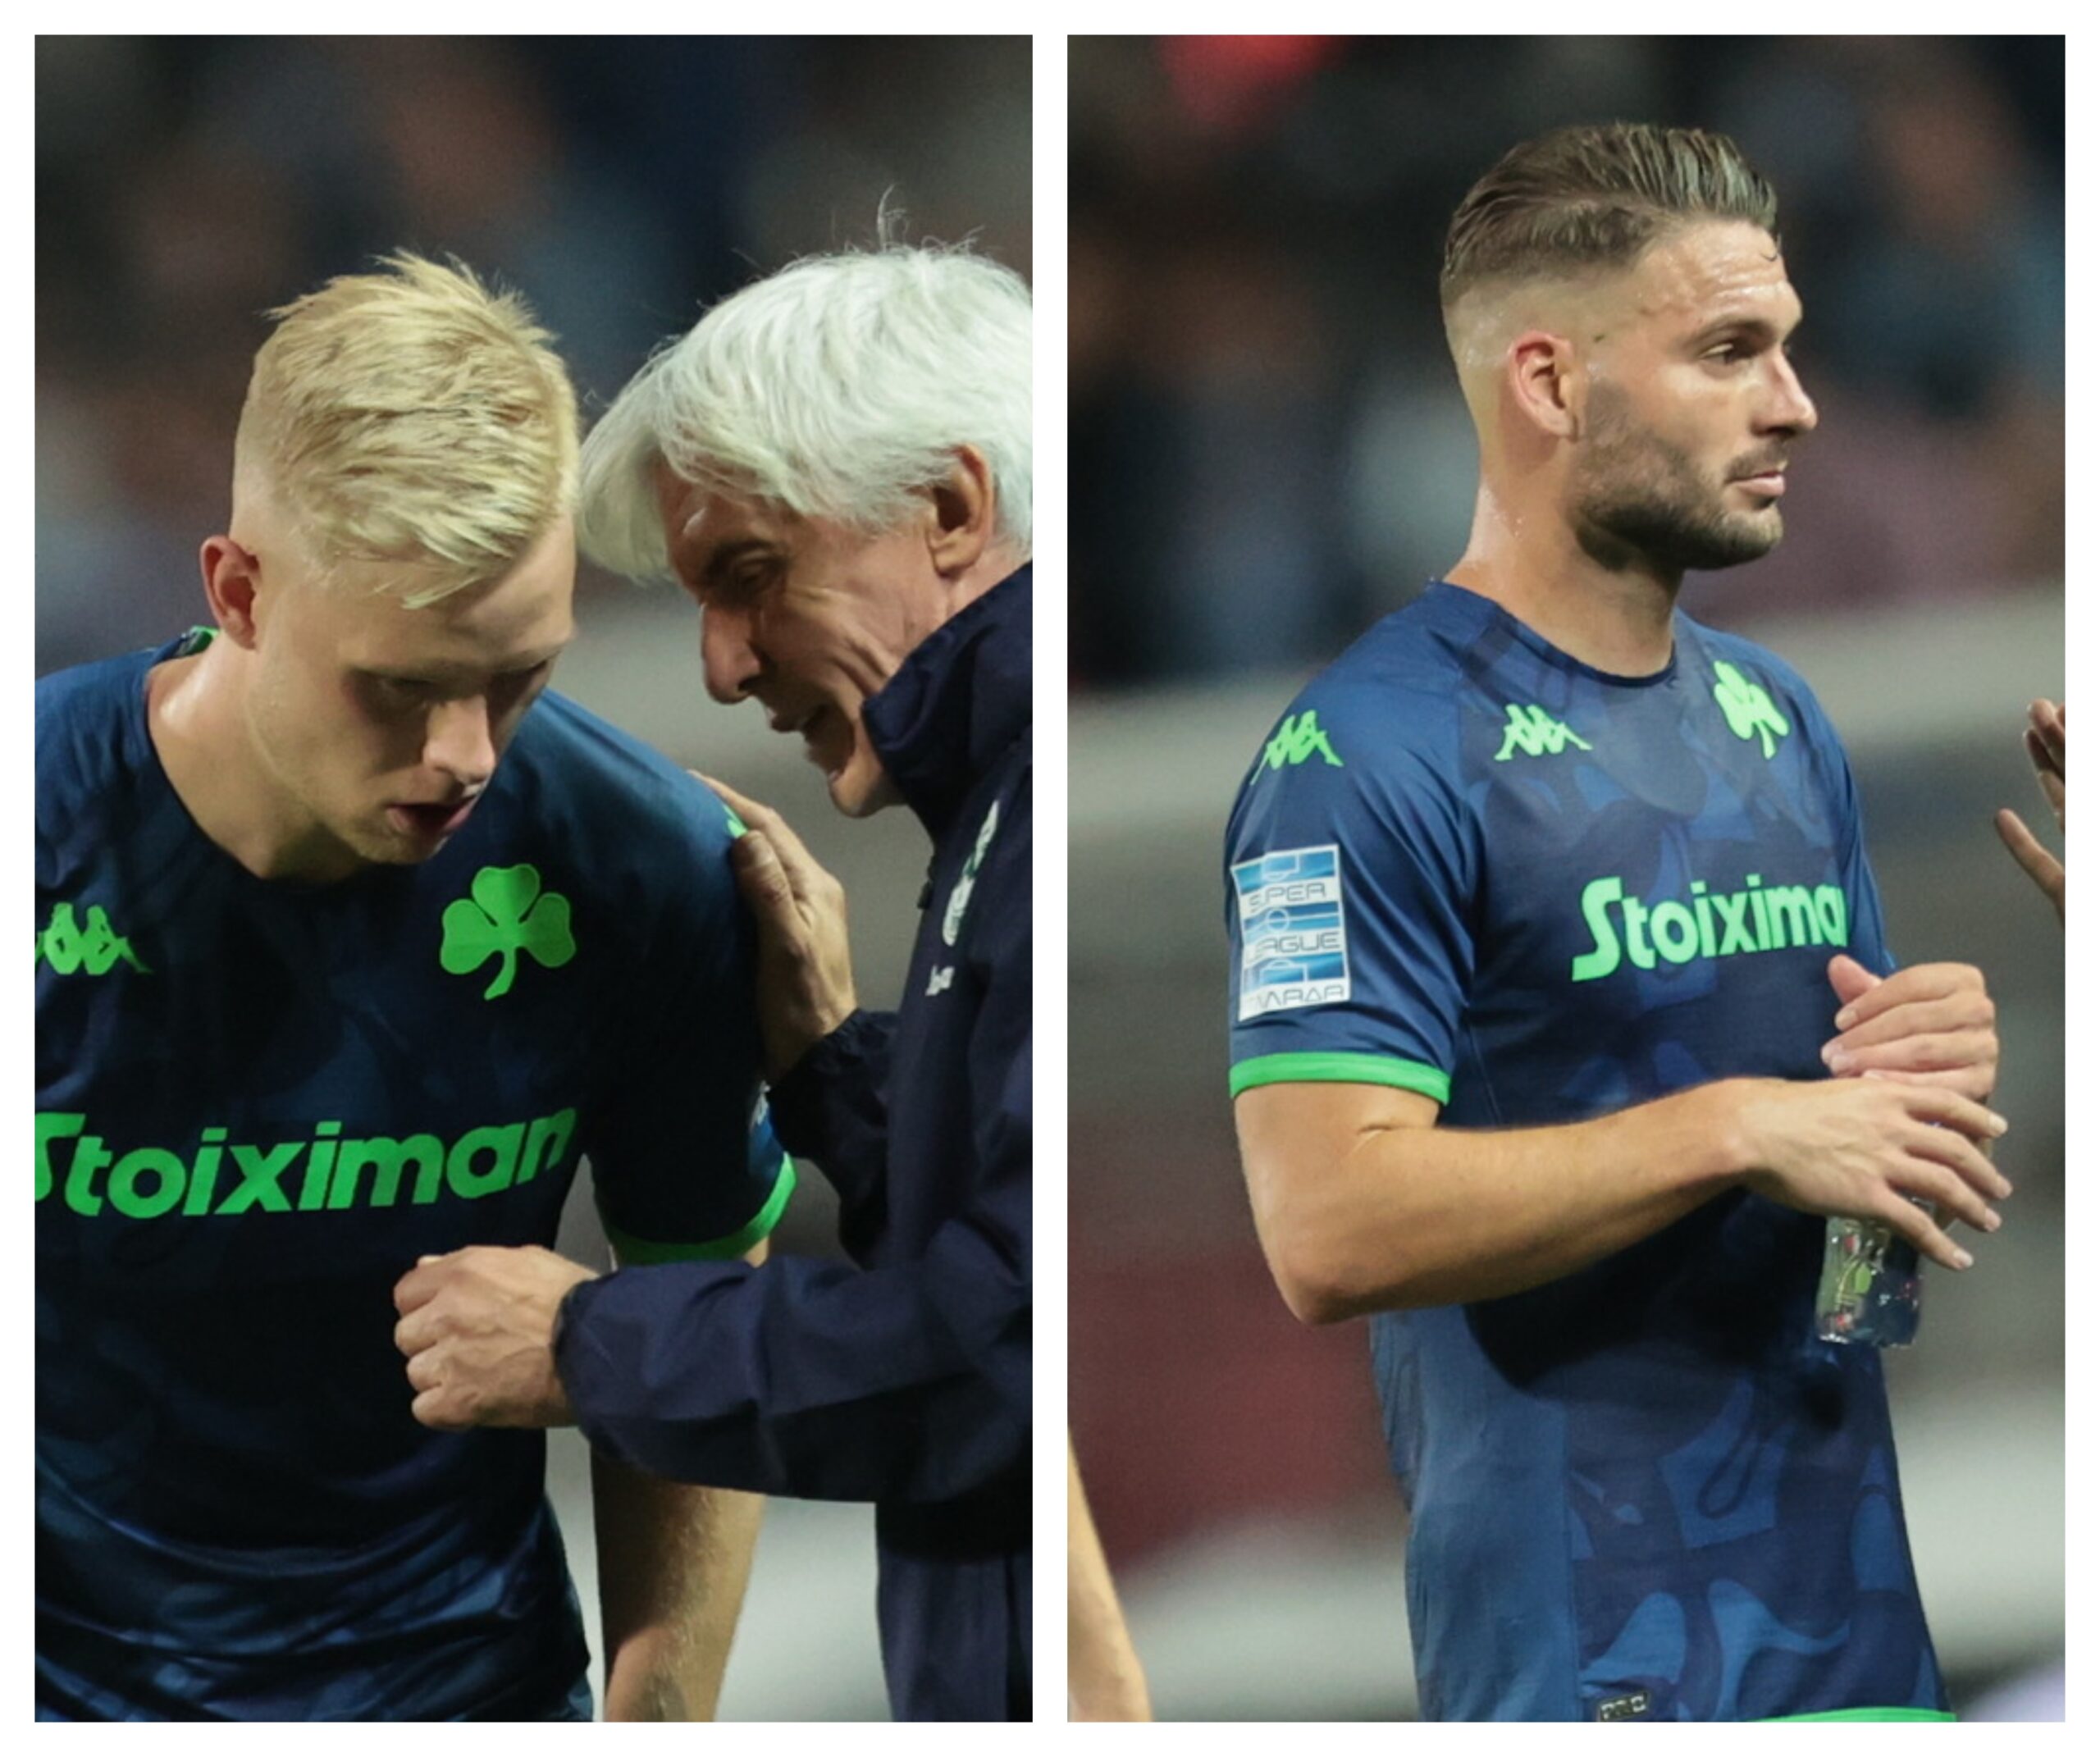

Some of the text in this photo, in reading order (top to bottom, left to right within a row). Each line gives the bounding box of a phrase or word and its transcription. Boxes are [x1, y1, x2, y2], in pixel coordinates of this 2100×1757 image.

[1249, 882, 1326, 912] SPER
[1572, 874, 1847, 981] Stoixima
[1250, 931, 1340, 961] AGUE
[34, 1108, 576, 1219] Stoiximan
